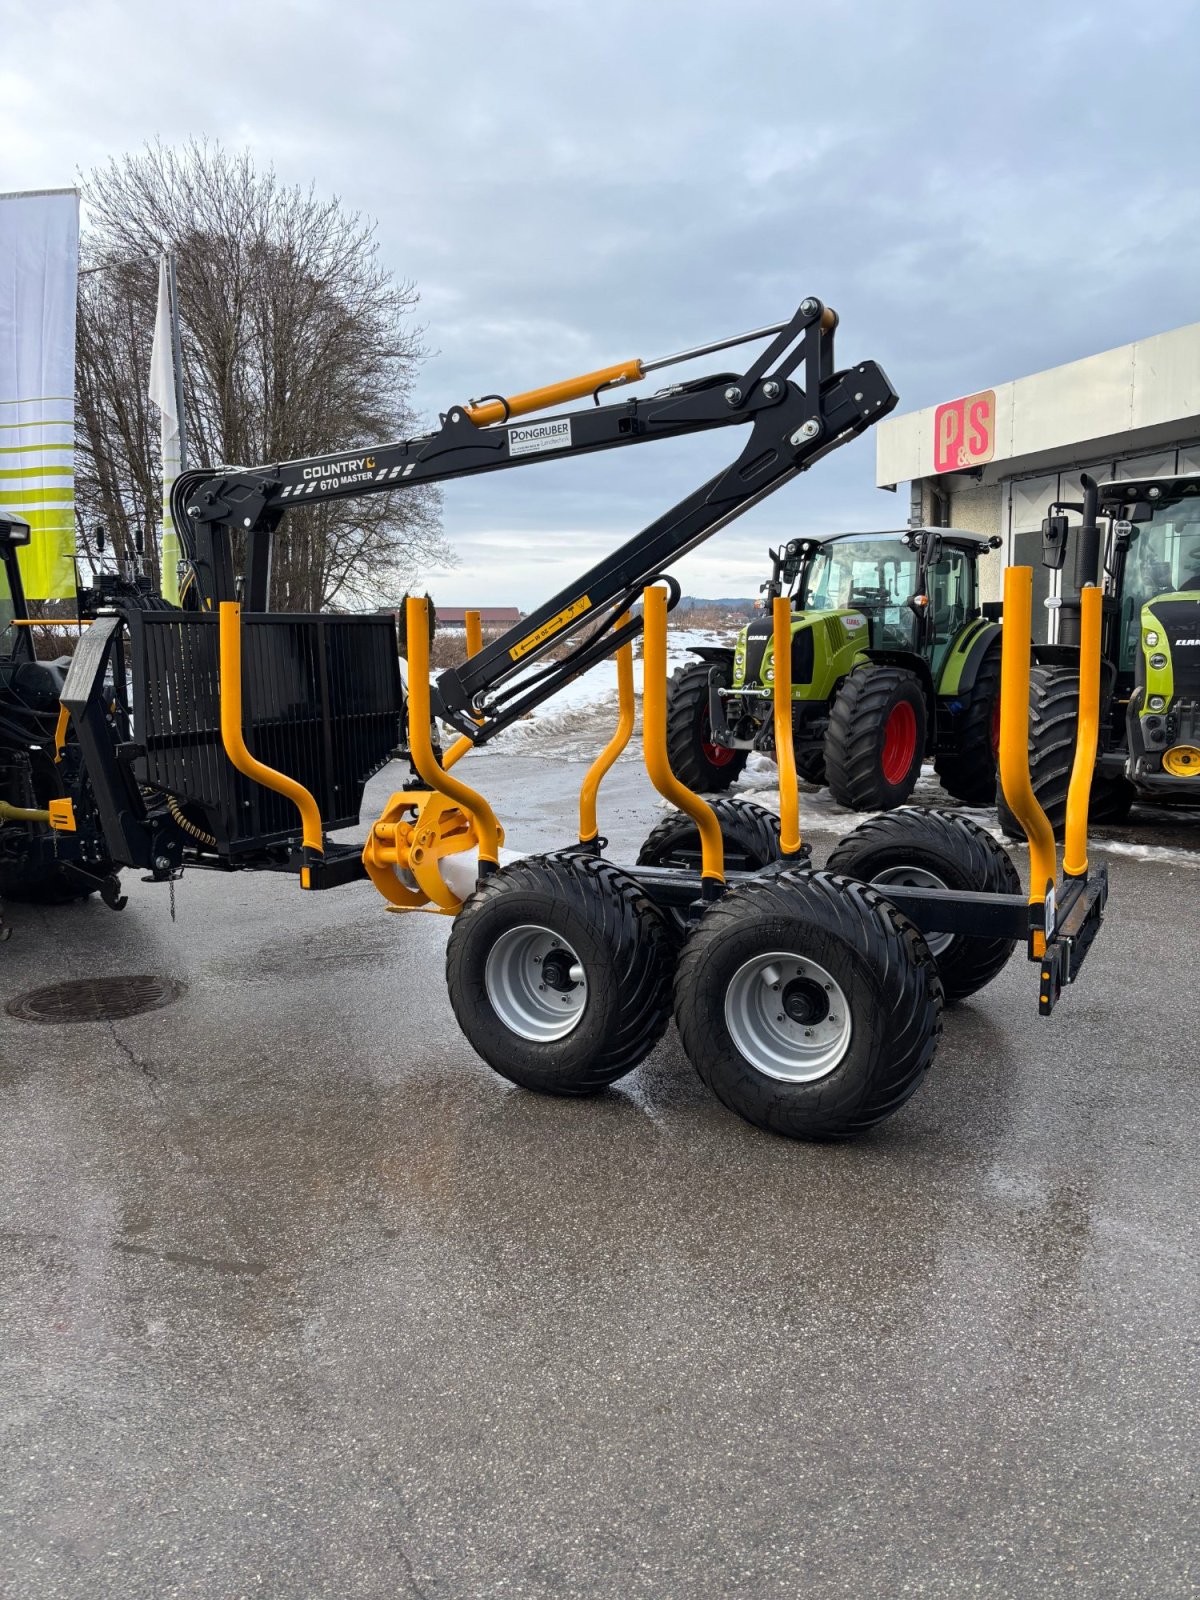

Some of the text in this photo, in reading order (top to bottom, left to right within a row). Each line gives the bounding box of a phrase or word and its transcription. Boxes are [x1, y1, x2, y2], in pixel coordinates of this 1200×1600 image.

[511, 423, 569, 444] PONGRUBER
[303, 458, 366, 480] COUNTRY
[320, 471, 373, 491] 670 MASTER
